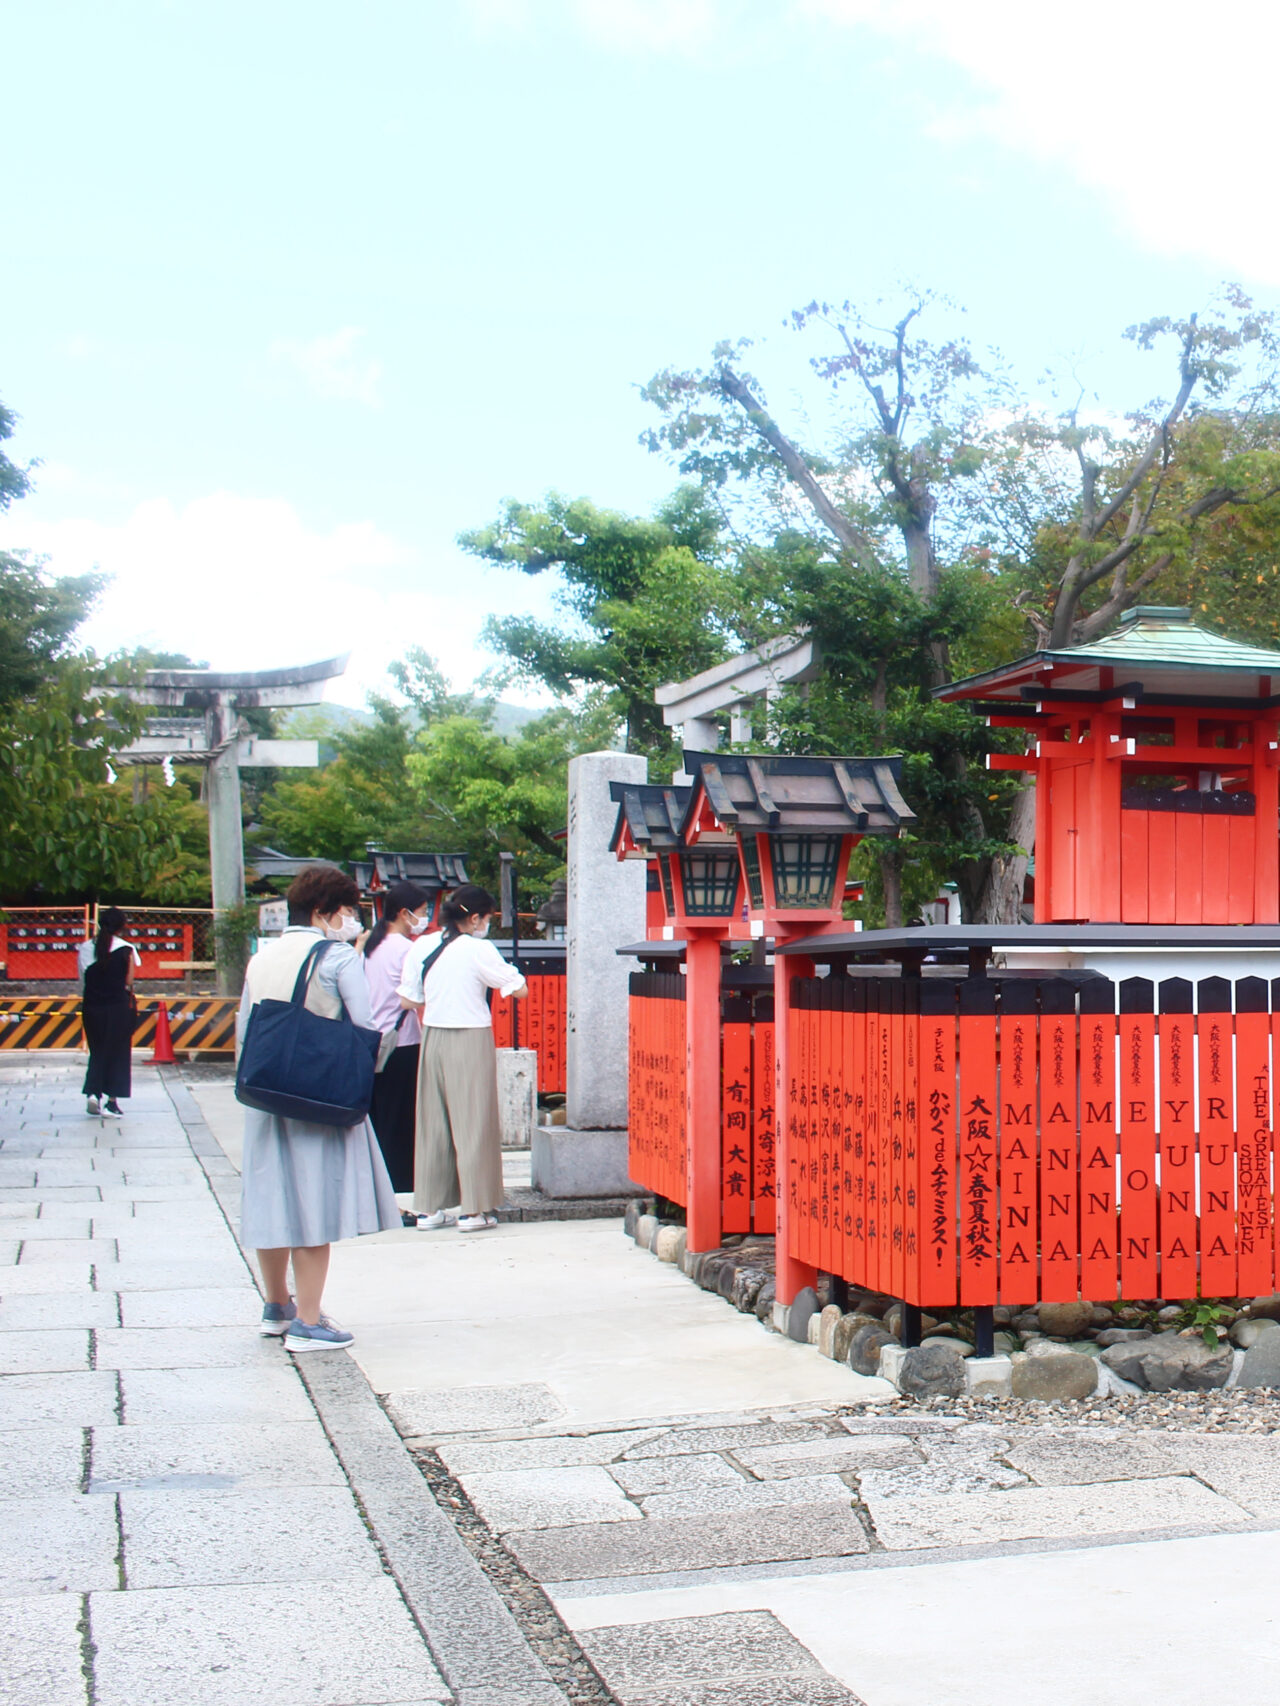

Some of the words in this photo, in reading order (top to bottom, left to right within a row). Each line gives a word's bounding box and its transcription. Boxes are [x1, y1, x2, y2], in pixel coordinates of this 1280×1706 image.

[726, 1080, 748, 1197] 有岡大貴
[1254, 1076, 1269, 1118] THE
[1005, 1104, 1032, 1264] MAINA
[1048, 1102, 1072, 1261] ANNA
[1086, 1101, 1112, 1260] MANA
[1127, 1101, 1150, 1259] EON
[1165, 1101, 1190, 1259] YUNA
[1207, 1097, 1231, 1257] RUNA
[1254, 1127, 1269, 1239] GREATEST
